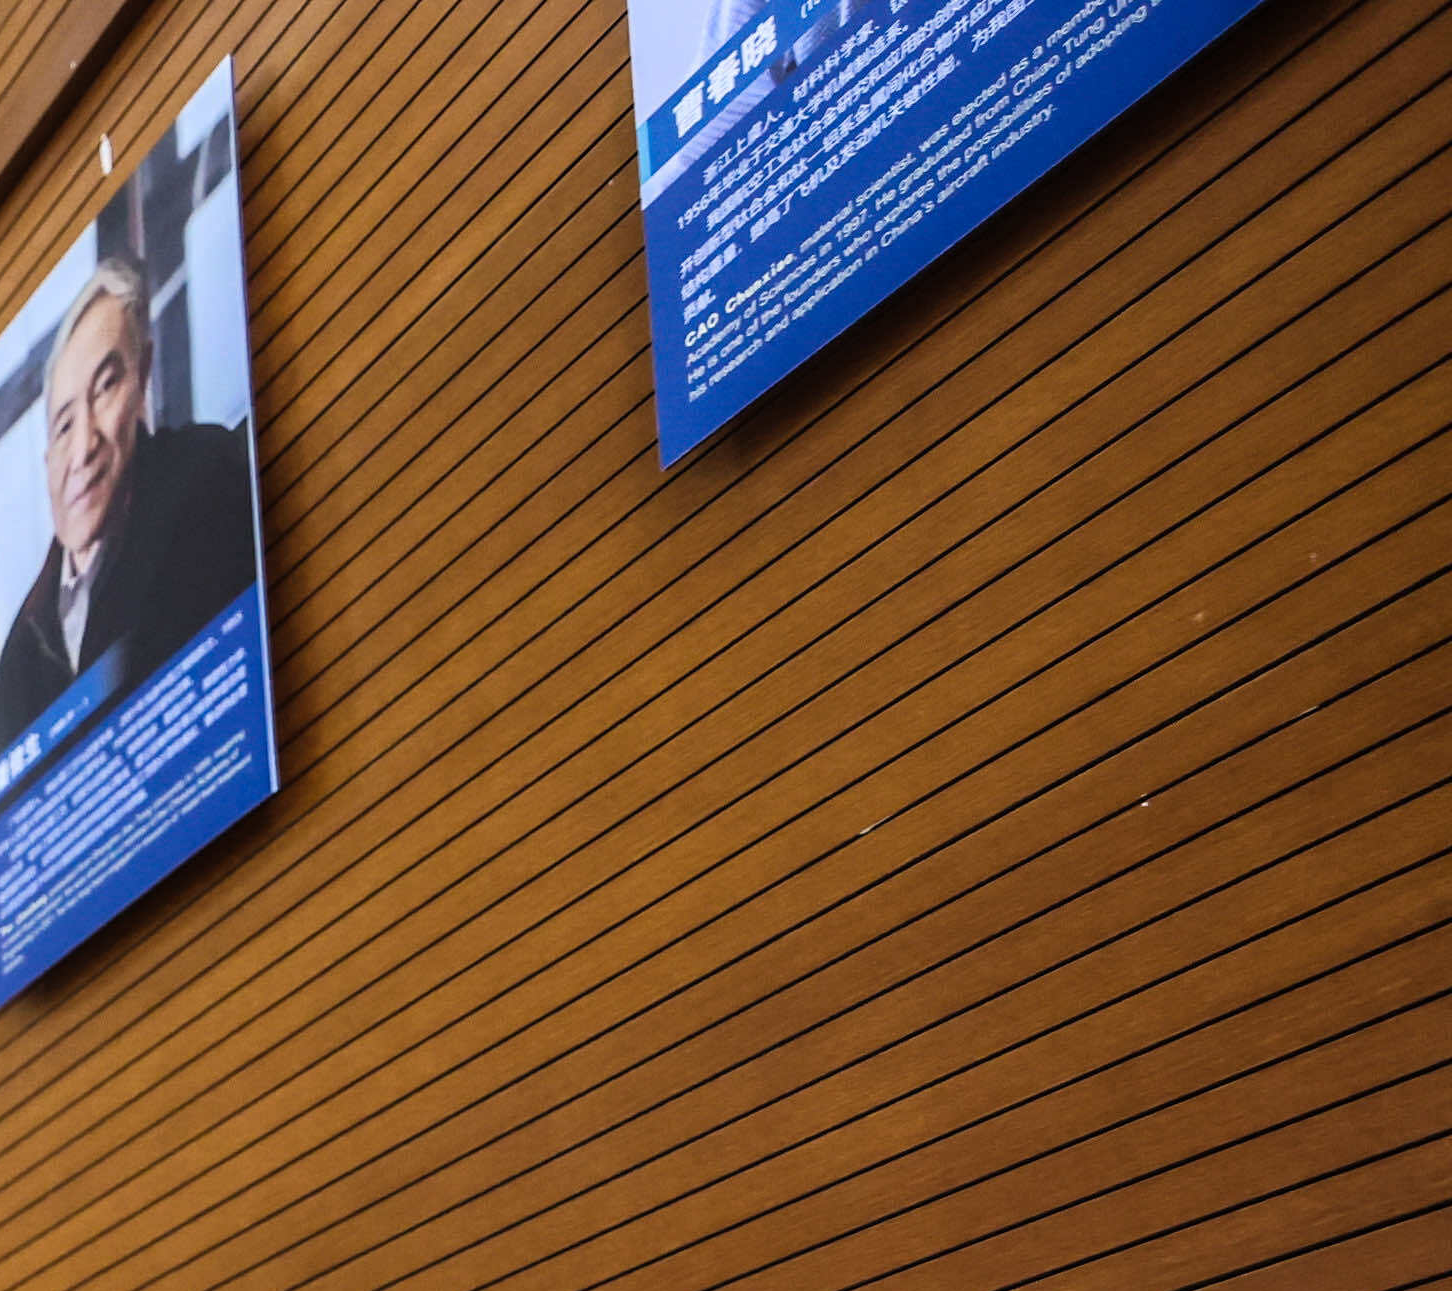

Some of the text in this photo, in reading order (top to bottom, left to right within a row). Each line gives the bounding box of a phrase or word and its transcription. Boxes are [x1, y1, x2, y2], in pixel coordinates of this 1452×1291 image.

[673, 16, 778, 138] 曹春晓
[684, 312, 720, 347] CAO
[800, 200, 853, 253] material
[918, 124, 949, 152] was
[951, 72, 1007, 126] elected
[1010, 57, 1029, 79] as
[1032, 45, 1043, 60] a
[686, 317, 741, 367] Academy
[743, 299, 757, 319] of
[758, 254, 817, 307] Sciences
[875, 189, 896, 211] He
[898, 123, 972, 195] graduated
[974, 95, 1010, 129] from
[1012, 54, 1059, 96] Chiao
[1063, 16, 1105, 54] Tung
[687, 5, 1147, 385] He is one of the founders who explores the possibilities of adopting
[689, 383, 708, 402] his
[708, 338, 763, 386] research
[765, 314, 789, 342] and
[791, 258, 862, 321] application
[865, 245, 878, 261] in
[880, 200, 935, 247] China's
[937, 154, 989, 204] aircraft
